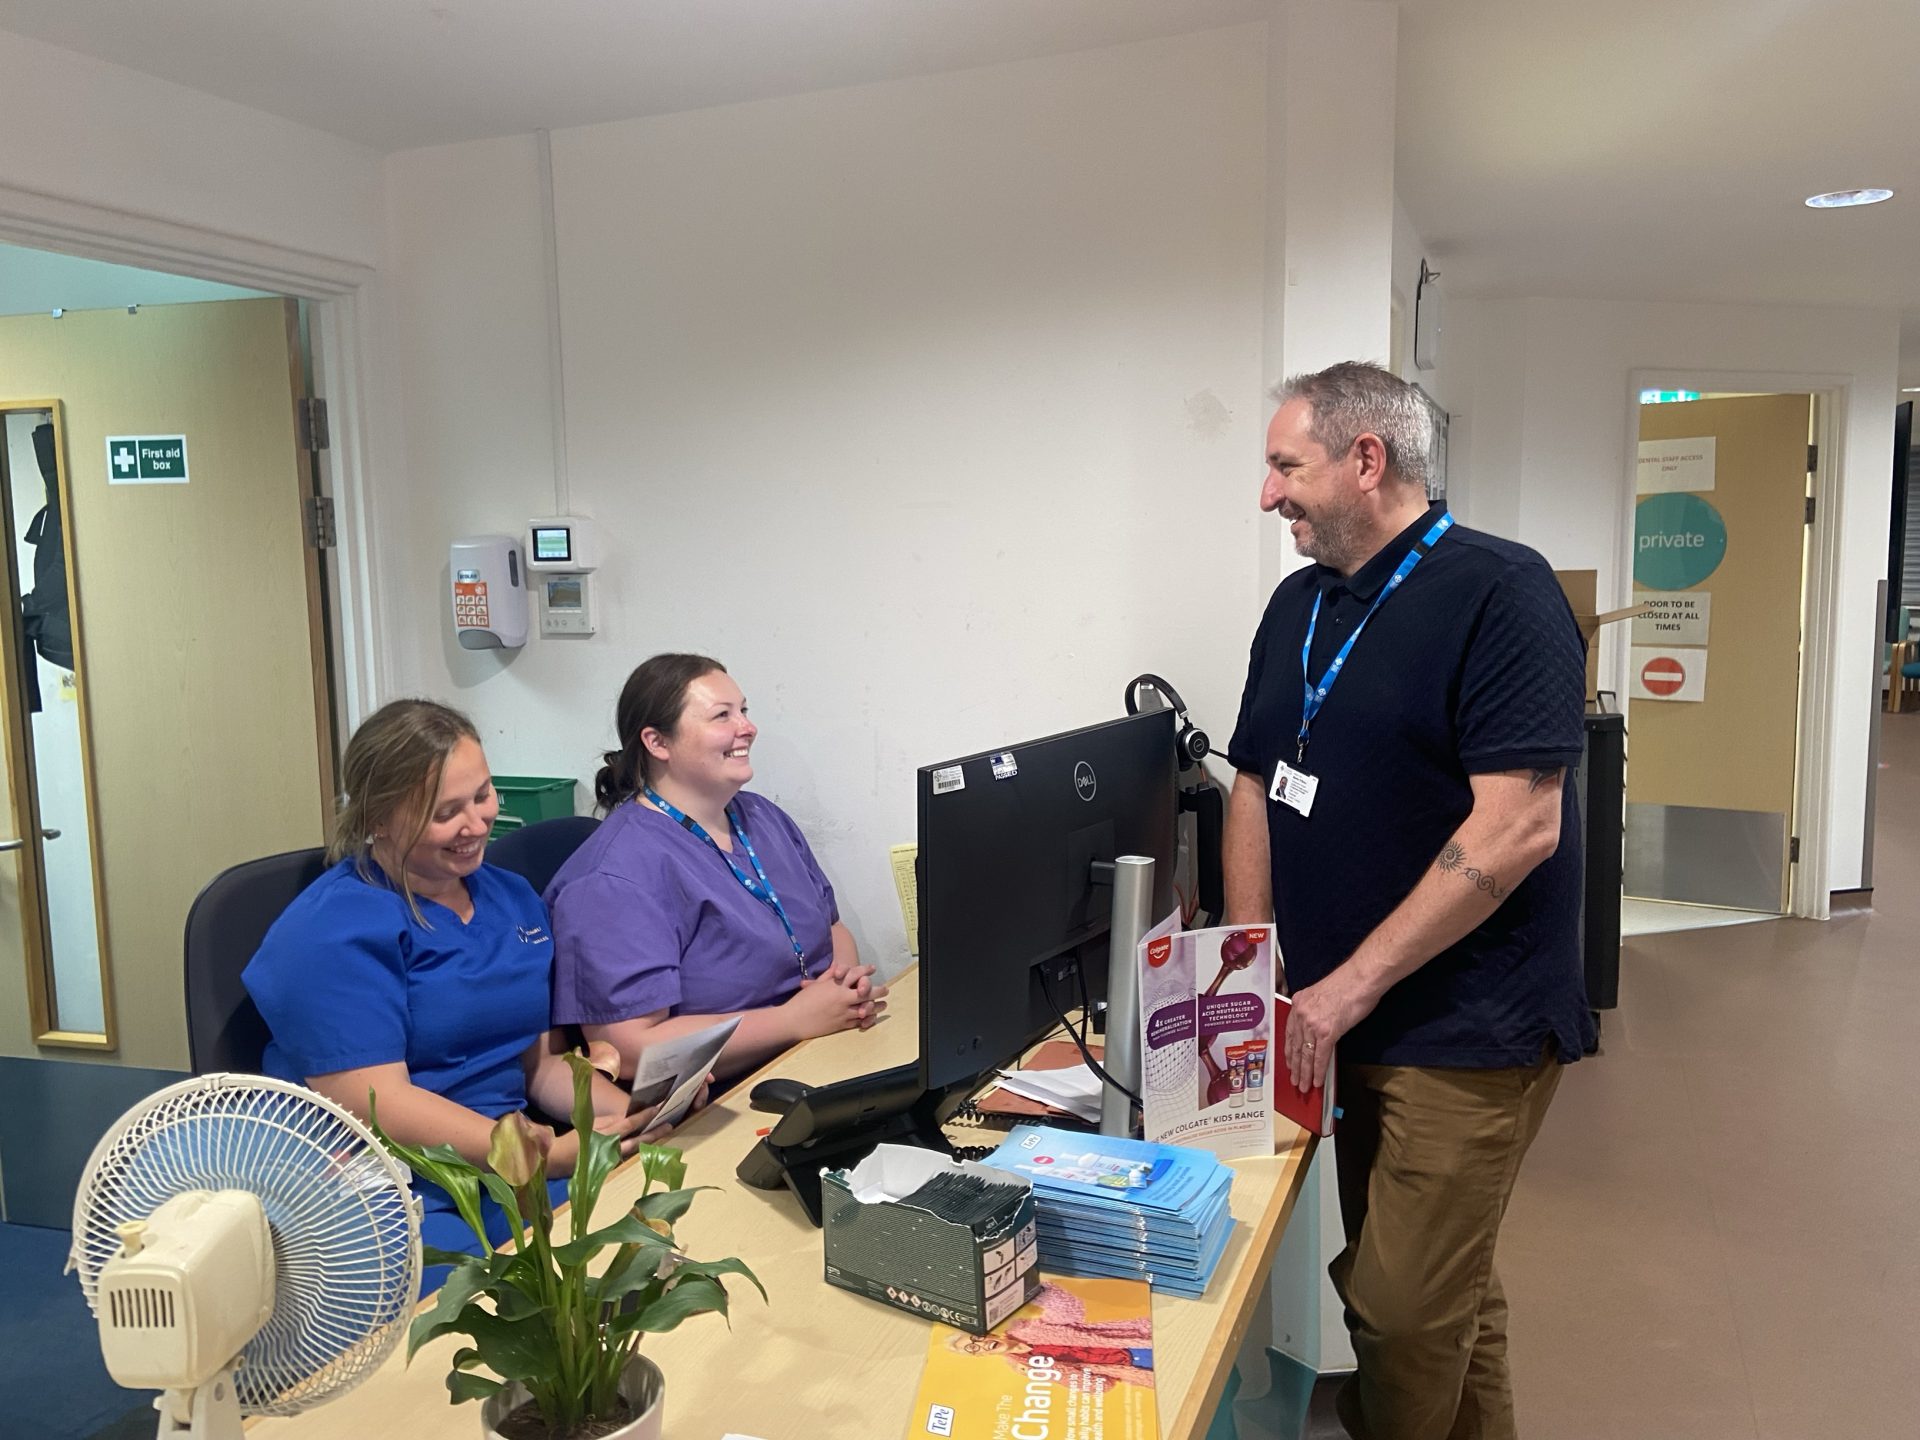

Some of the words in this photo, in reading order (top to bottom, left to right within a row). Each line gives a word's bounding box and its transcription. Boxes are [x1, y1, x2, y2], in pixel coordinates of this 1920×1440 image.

[142, 448, 164, 459] First
[165, 448, 181, 459] aid
[1681, 454, 1704, 462] ACCESS
[152, 460, 171, 470] box
[1639, 531, 1705, 552] private
[1684, 612, 1700, 620] ALL
[1655, 623, 1681, 631] TIMES
[1077, 775, 1094, 788] DELL
[1149, 944, 1169, 955] Colgate
[1209, 1013, 1249, 1021] TECHNOLOGY
[1160, 1129, 1175, 1140] NEW
[1213, 1113, 1233, 1123] KIDS
[1234, 1111, 1265, 1120] RANGE
[1082, 1367, 1092, 1392] improve
[1011, 1355, 1062, 1440] Change
[1066, 1381, 1079, 1407] changes
[1081, 1393, 1090, 1405] can
[1092, 1377, 1106, 1408] wellbeing
[996, 1394, 1013, 1412] The
[931, 1408, 950, 1431] TePe
[1065, 1407, 1077, 1426] small
[993, 1413, 1010, 1440] Make
[1064, 1426, 1077, 1440] ow
